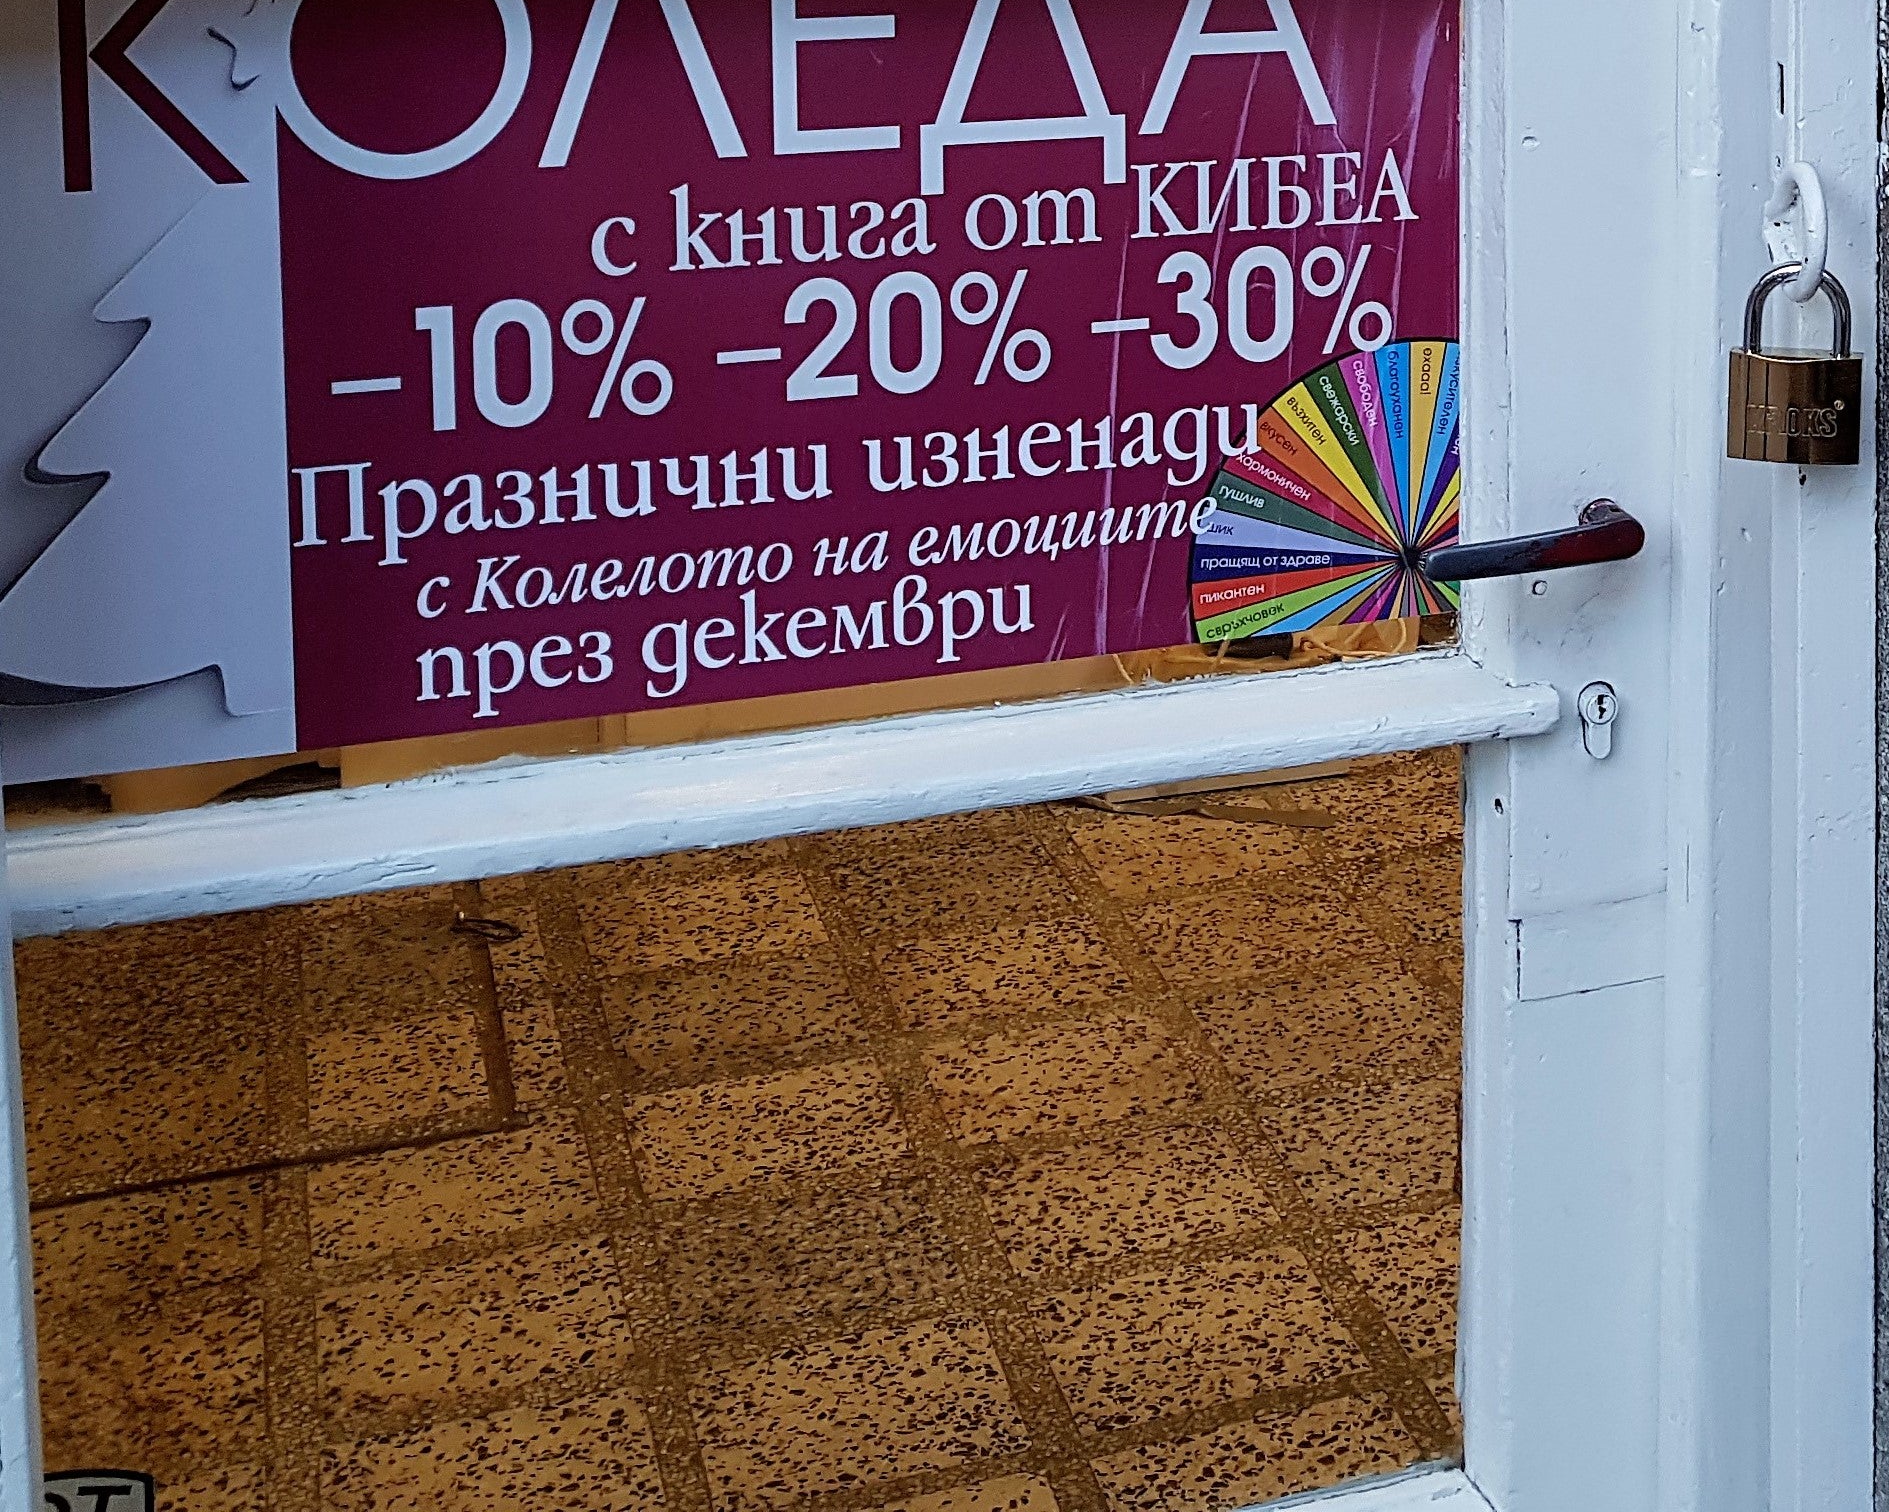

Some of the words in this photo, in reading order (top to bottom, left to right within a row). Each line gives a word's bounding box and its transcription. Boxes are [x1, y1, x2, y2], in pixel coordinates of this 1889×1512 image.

[591, 215, 638, 276] с
[668, 183, 937, 273] книга
[963, 187, 1102, 252] от
[1130, 148, 1420, 239] КИБЕА
[1286, 395, 1328, 446] възхитен
[1318, 375, 1361, 446] свежарски
[1352, 360, 1379, 428] свободен
[1387, 350, 1404, 439] благоуханен
[1259, 420, 1299, 456] вкусен
[292, 439, 829, 567] Празнични
[867, 400, 1261, 492] изненади
[1218, 485, 1266, 509] гушлив
[1235, 452, 1312, 501] хармоничен
[417, 576, 451, 618] с
[466, 540, 796, 614] Колелото
[816, 527, 890, 578] на
[909, 494, 1219, 571] емоциите
[1200, 555, 1261, 571] пращящ
[1263, 555, 1278, 567] от
[1280, 552, 1331, 568] здраве
[1199, 582, 1266, 606] пикантен
[1205, 601, 1285, 640] свръхчовек
[415, 631, 614, 720] през
[643, 580, 1036, 699] декември
